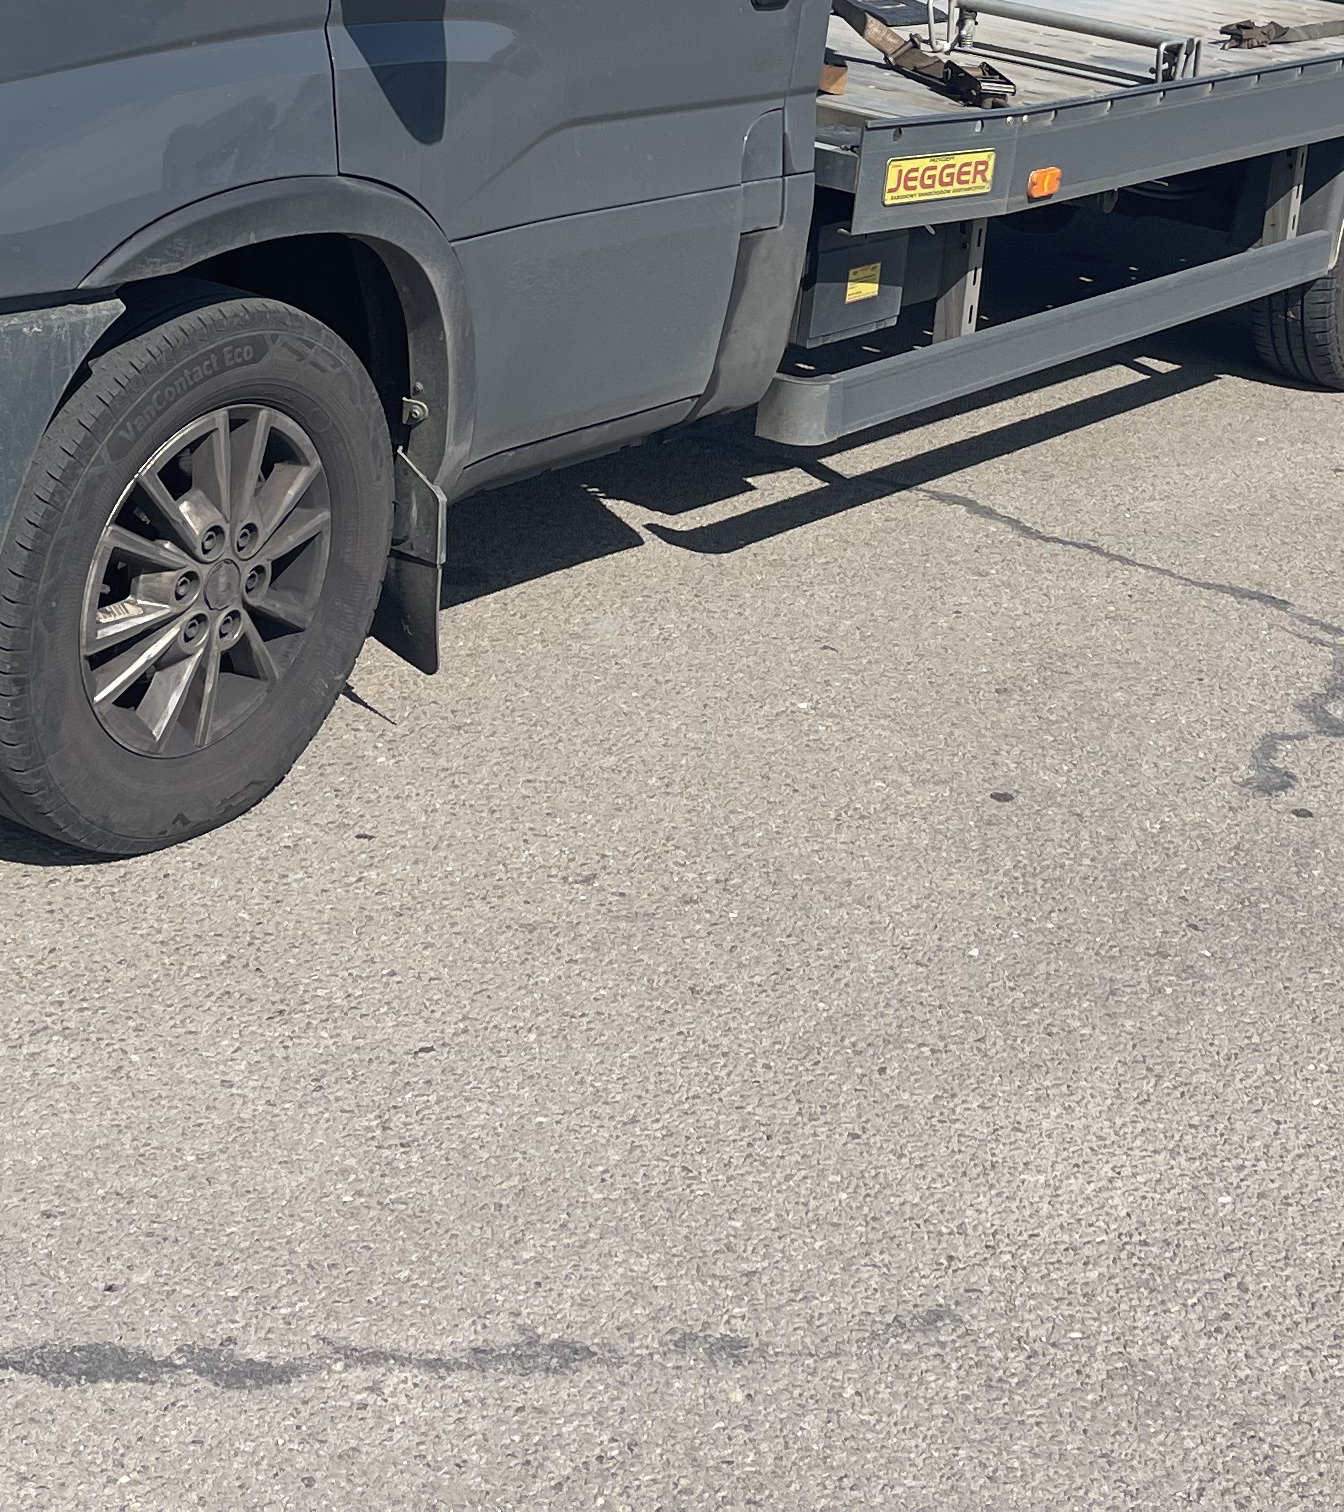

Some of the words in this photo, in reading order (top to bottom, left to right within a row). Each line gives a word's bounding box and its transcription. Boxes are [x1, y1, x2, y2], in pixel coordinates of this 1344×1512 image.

[887, 160, 990, 194] JEGGER
[119, 353, 220, 441] VanContact
[223, 345, 254, 367] Eco
